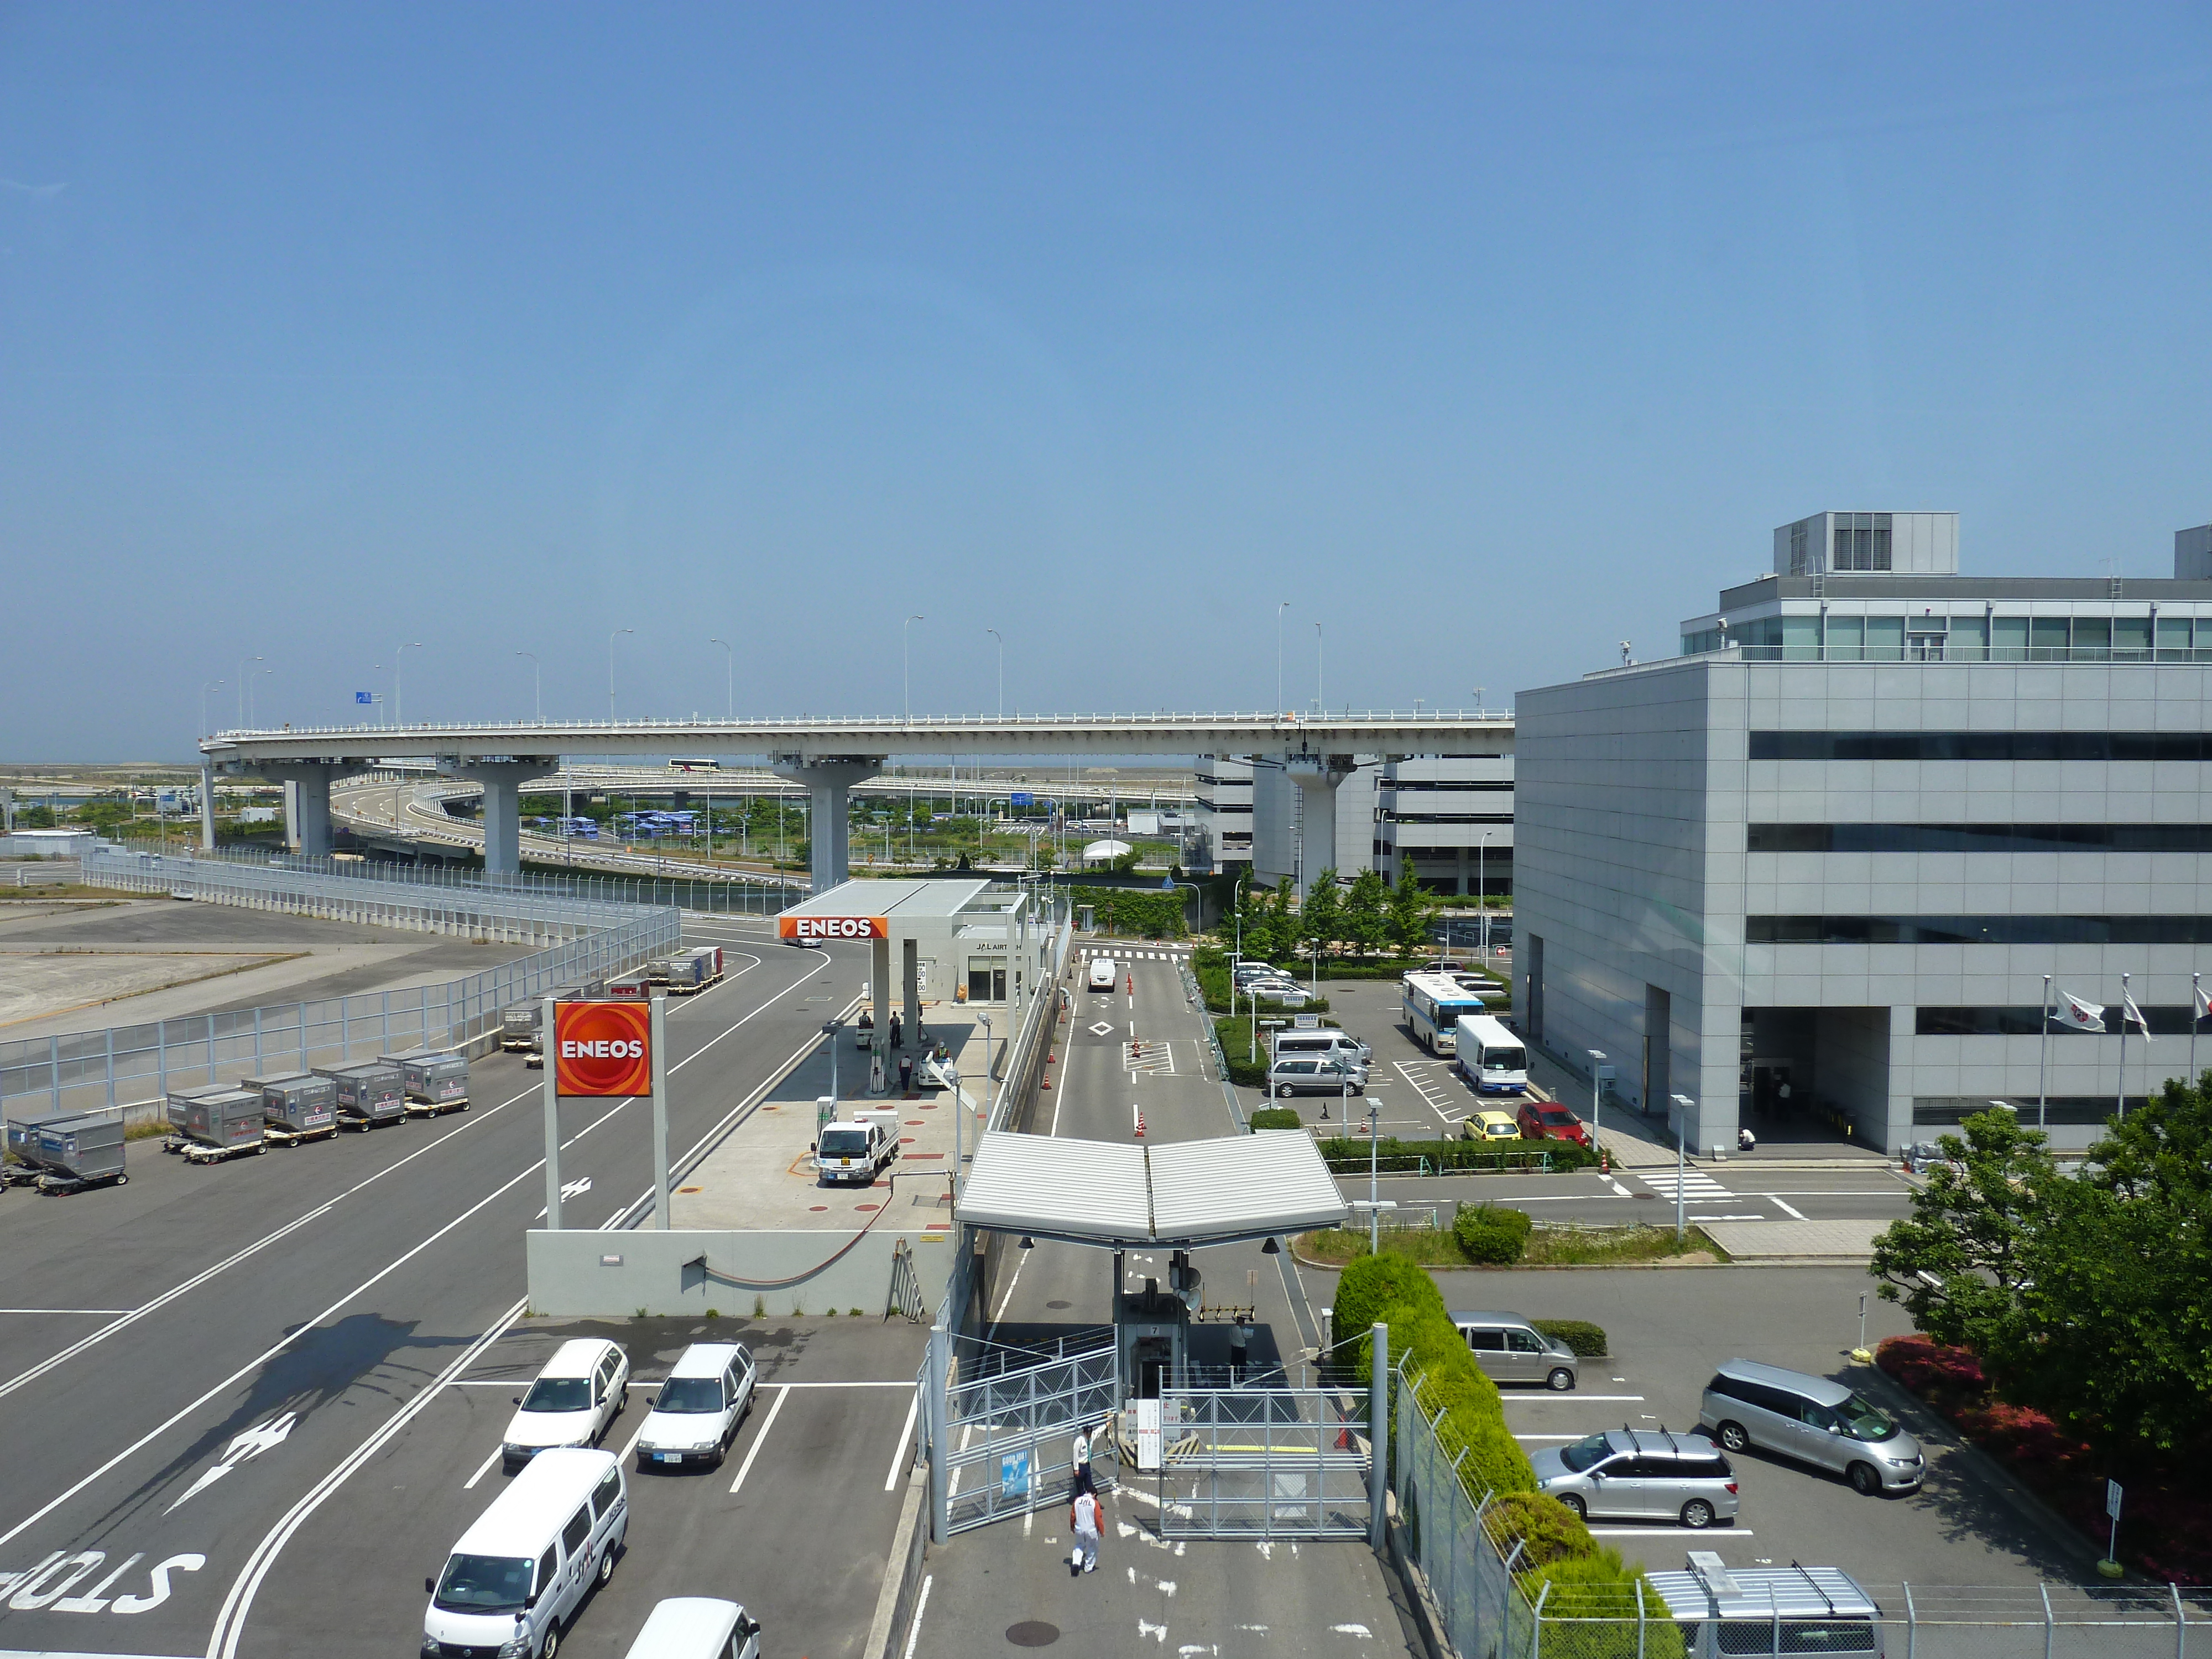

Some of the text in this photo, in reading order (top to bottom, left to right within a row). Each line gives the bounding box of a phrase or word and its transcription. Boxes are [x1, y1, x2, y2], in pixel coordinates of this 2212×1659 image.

[797, 919, 872, 937] ENEOS
[977, 942, 992, 952] JAL
[562, 1040, 643, 1059] ENEOS
[607, 1493, 626, 1524] JGSK
[1078, 1498, 1092, 1507] JAL
[575, 1540, 597, 1585] JAL
